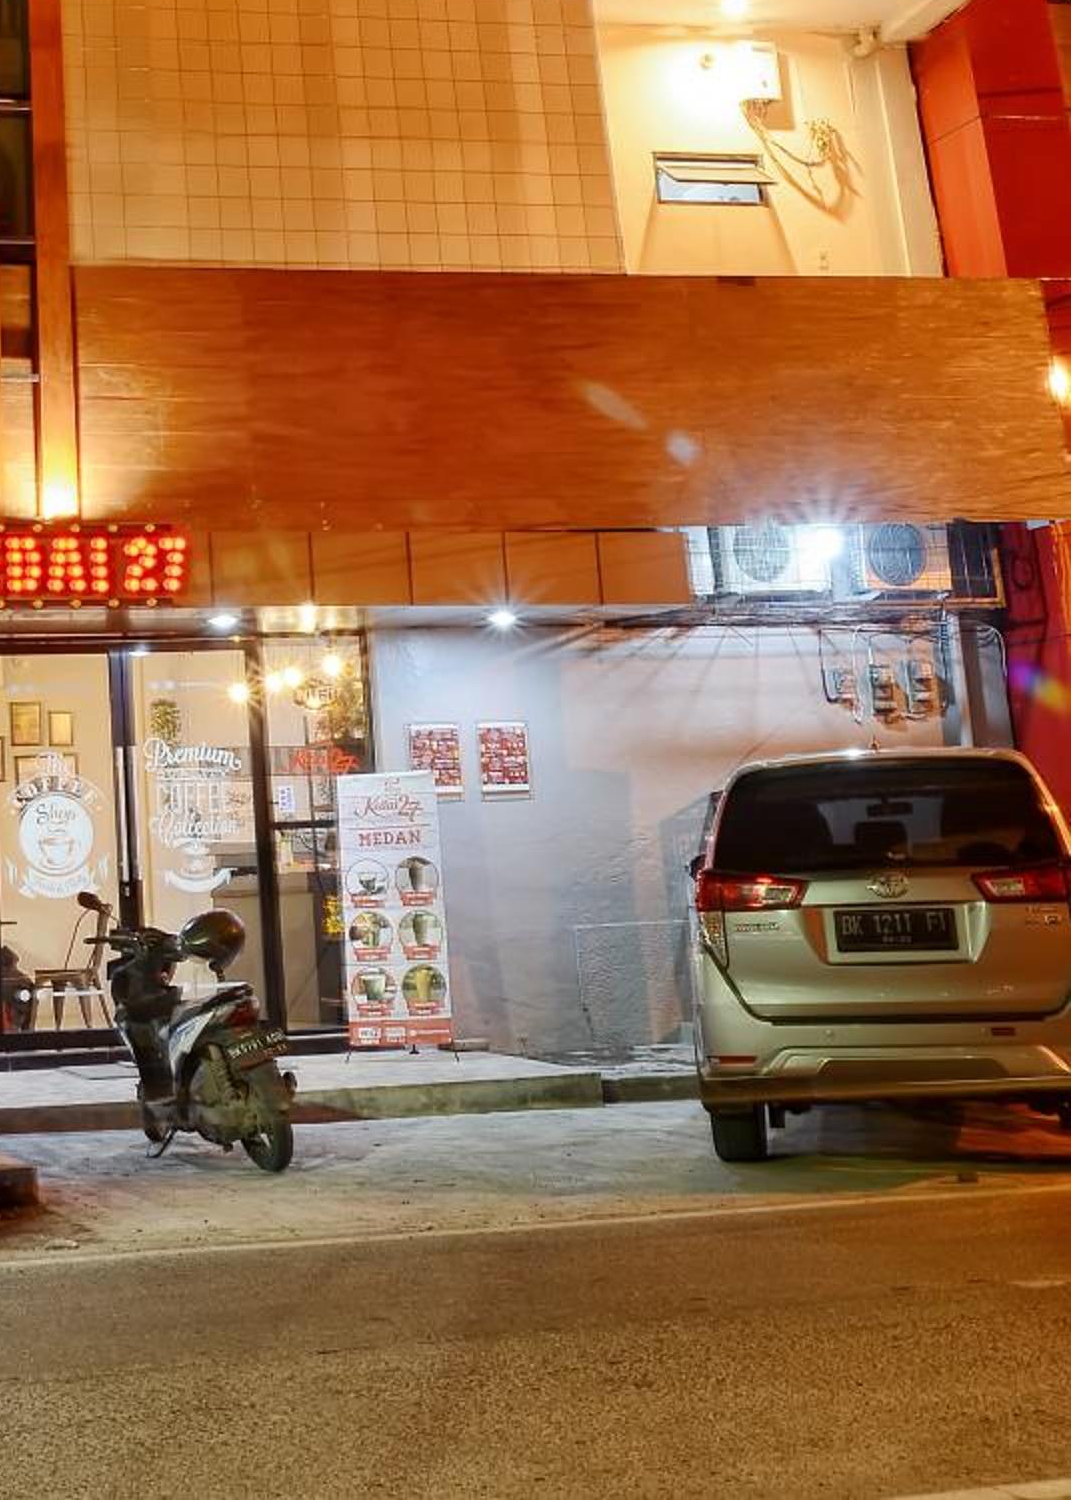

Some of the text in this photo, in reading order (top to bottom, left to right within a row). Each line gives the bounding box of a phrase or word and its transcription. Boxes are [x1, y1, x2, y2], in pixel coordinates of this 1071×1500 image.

[123, 536, 187, 593] 27
[144, 737, 242, 773] Premium
[358, 829, 421, 847] MEDAN
[841, 913, 865, 935] BK
